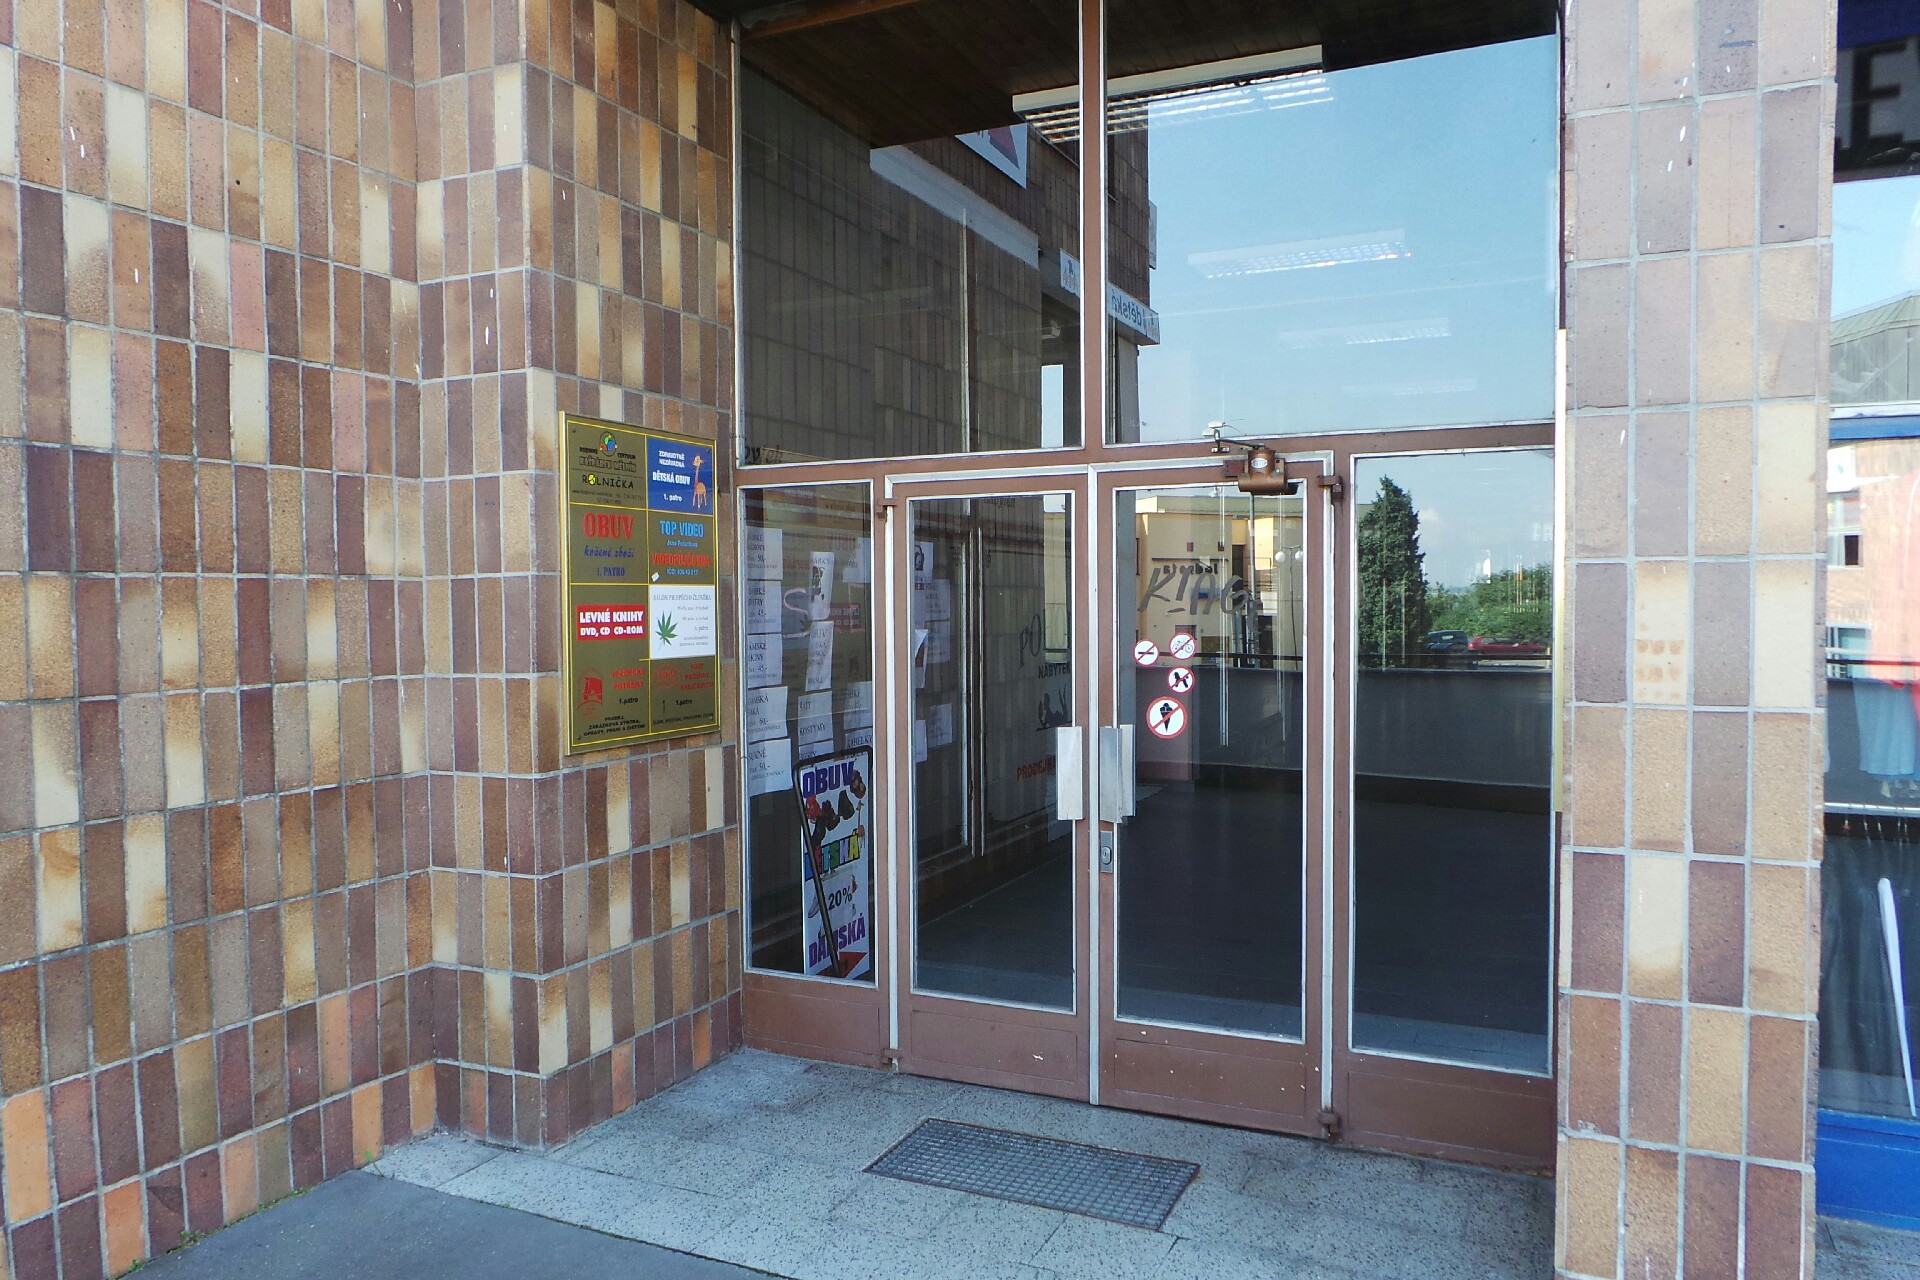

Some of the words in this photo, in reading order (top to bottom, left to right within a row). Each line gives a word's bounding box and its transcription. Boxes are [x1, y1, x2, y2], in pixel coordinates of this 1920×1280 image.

[582, 473, 634, 490] ROLNIČKA
[652, 469, 675, 484] DĚTSKÁ
[675, 475, 691, 485] OBUV
[669, 494, 682, 502] patro
[583, 512, 635, 539] OBUV
[660, 520, 677, 535] TOP
[679, 522, 704, 538] VIDEO
[584, 545, 611, 558] kožené
[603, 566, 625, 577] PATRO
[580, 608, 610, 624] LEVNÉ
[613, 611, 644, 622] KNIHY
[580, 627, 598, 637] DVD,
[600, 627, 610, 636] CD
[614, 626, 643, 635] CD-ROM
[803, 760, 854, 798] OBUV
[828, 885, 853, 911] 20%
